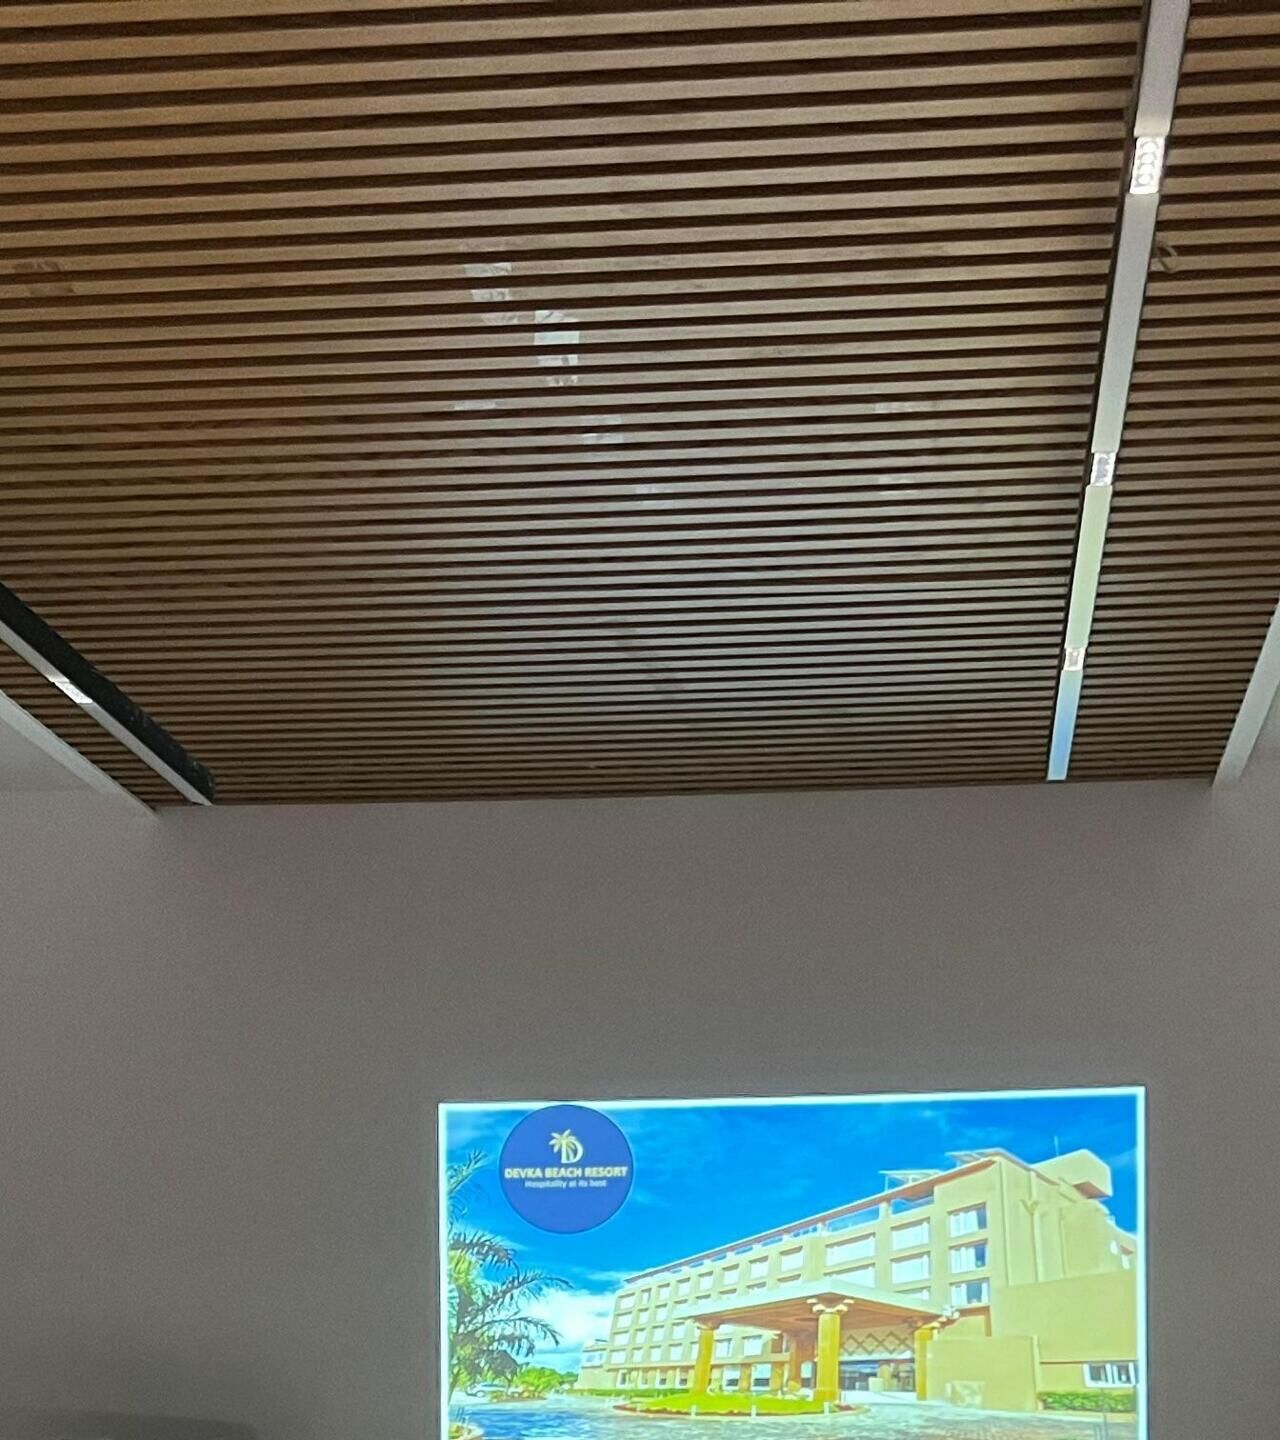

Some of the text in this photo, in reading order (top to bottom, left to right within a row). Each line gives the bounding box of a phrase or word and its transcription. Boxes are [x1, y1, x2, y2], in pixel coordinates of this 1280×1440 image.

[504, 1166, 628, 1179] DEVKA BEACH RESORT
